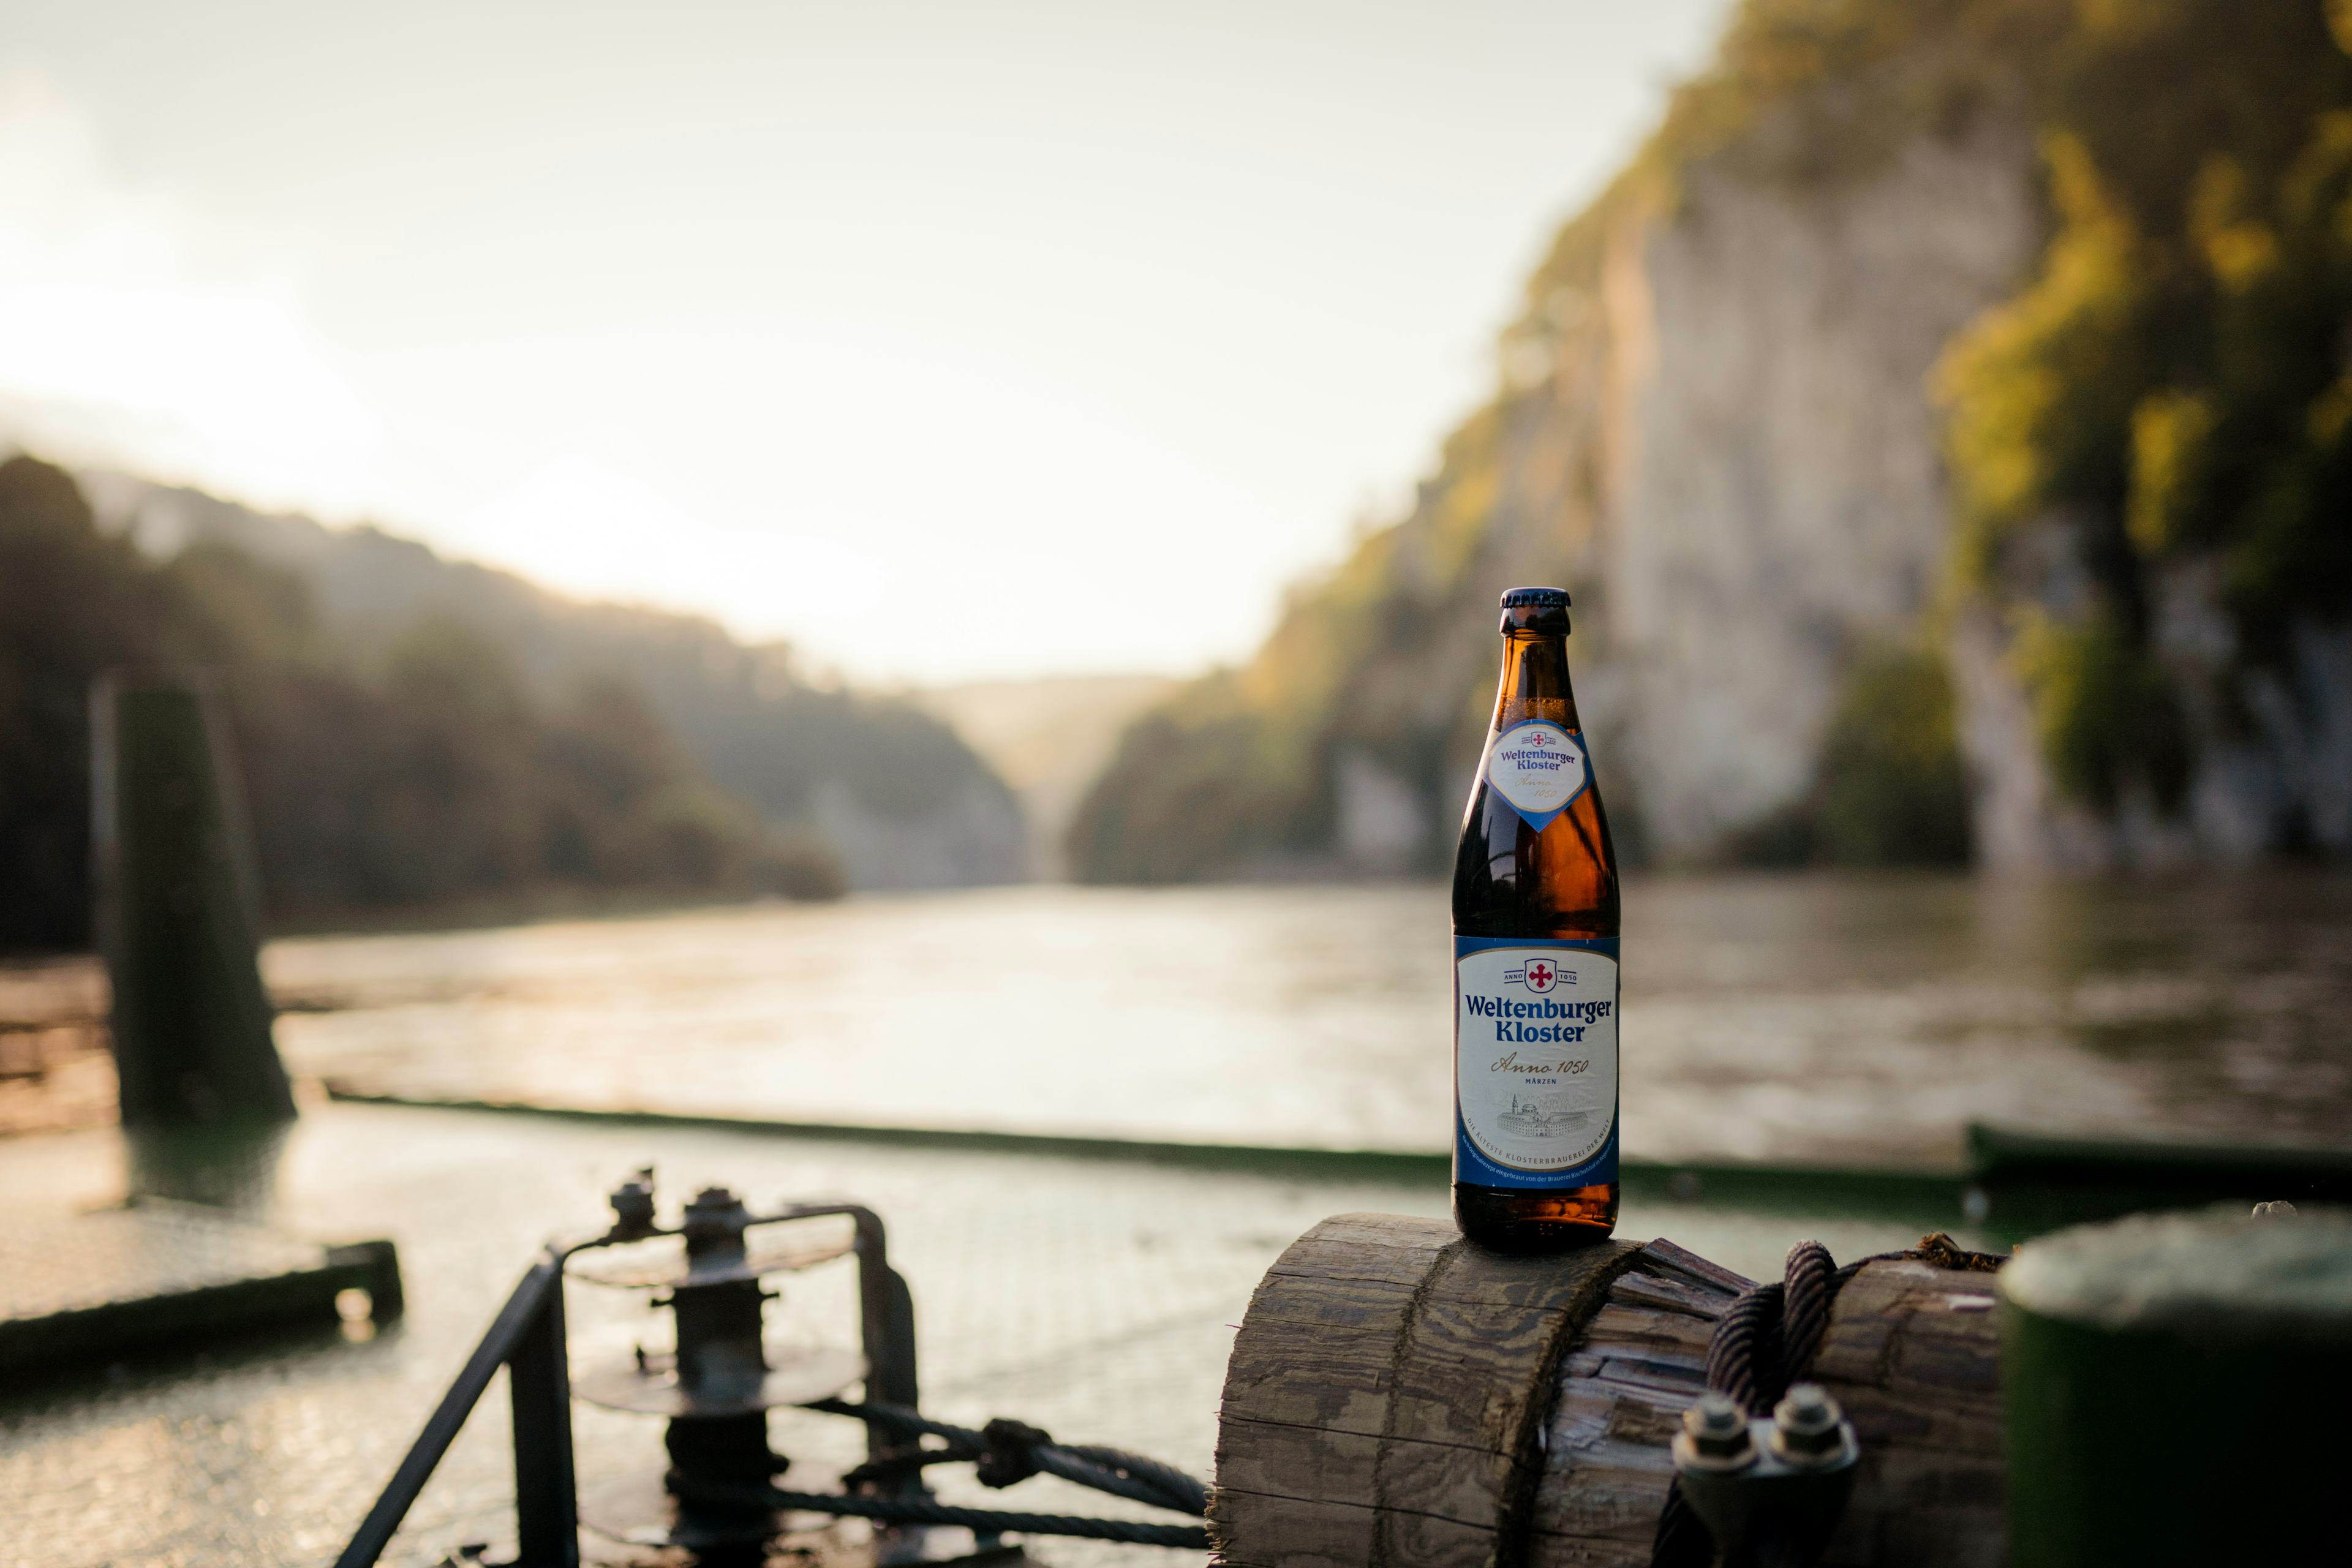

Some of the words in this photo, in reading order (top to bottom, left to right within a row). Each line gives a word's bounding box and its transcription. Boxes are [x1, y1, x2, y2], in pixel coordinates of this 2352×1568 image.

[1501, 750, 1575, 764] Weltenburger
[1517, 760, 1560, 771] Kloster
[1515, 774, 1552, 786] Anno
[1534, 790, 1557, 798] 1050
[1465, 995, 1611, 1023] Weltenburger
[1495, 1020, 1586, 1042] Kloster
[1490, 1052, 1552, 1074] Anno
[1556, 1060, 1589, 1074] 1050
[1467, 1117, 1476, 1131] DIE
[1506, 1149, 1585, 1164] KLOSTERBRAUEREI
[1586, 1139, 1599, 1152] DER
[1496, 1169, 1525, 1181] eingebraut
[1548, 1172, 1570, 1182] Brauerei
